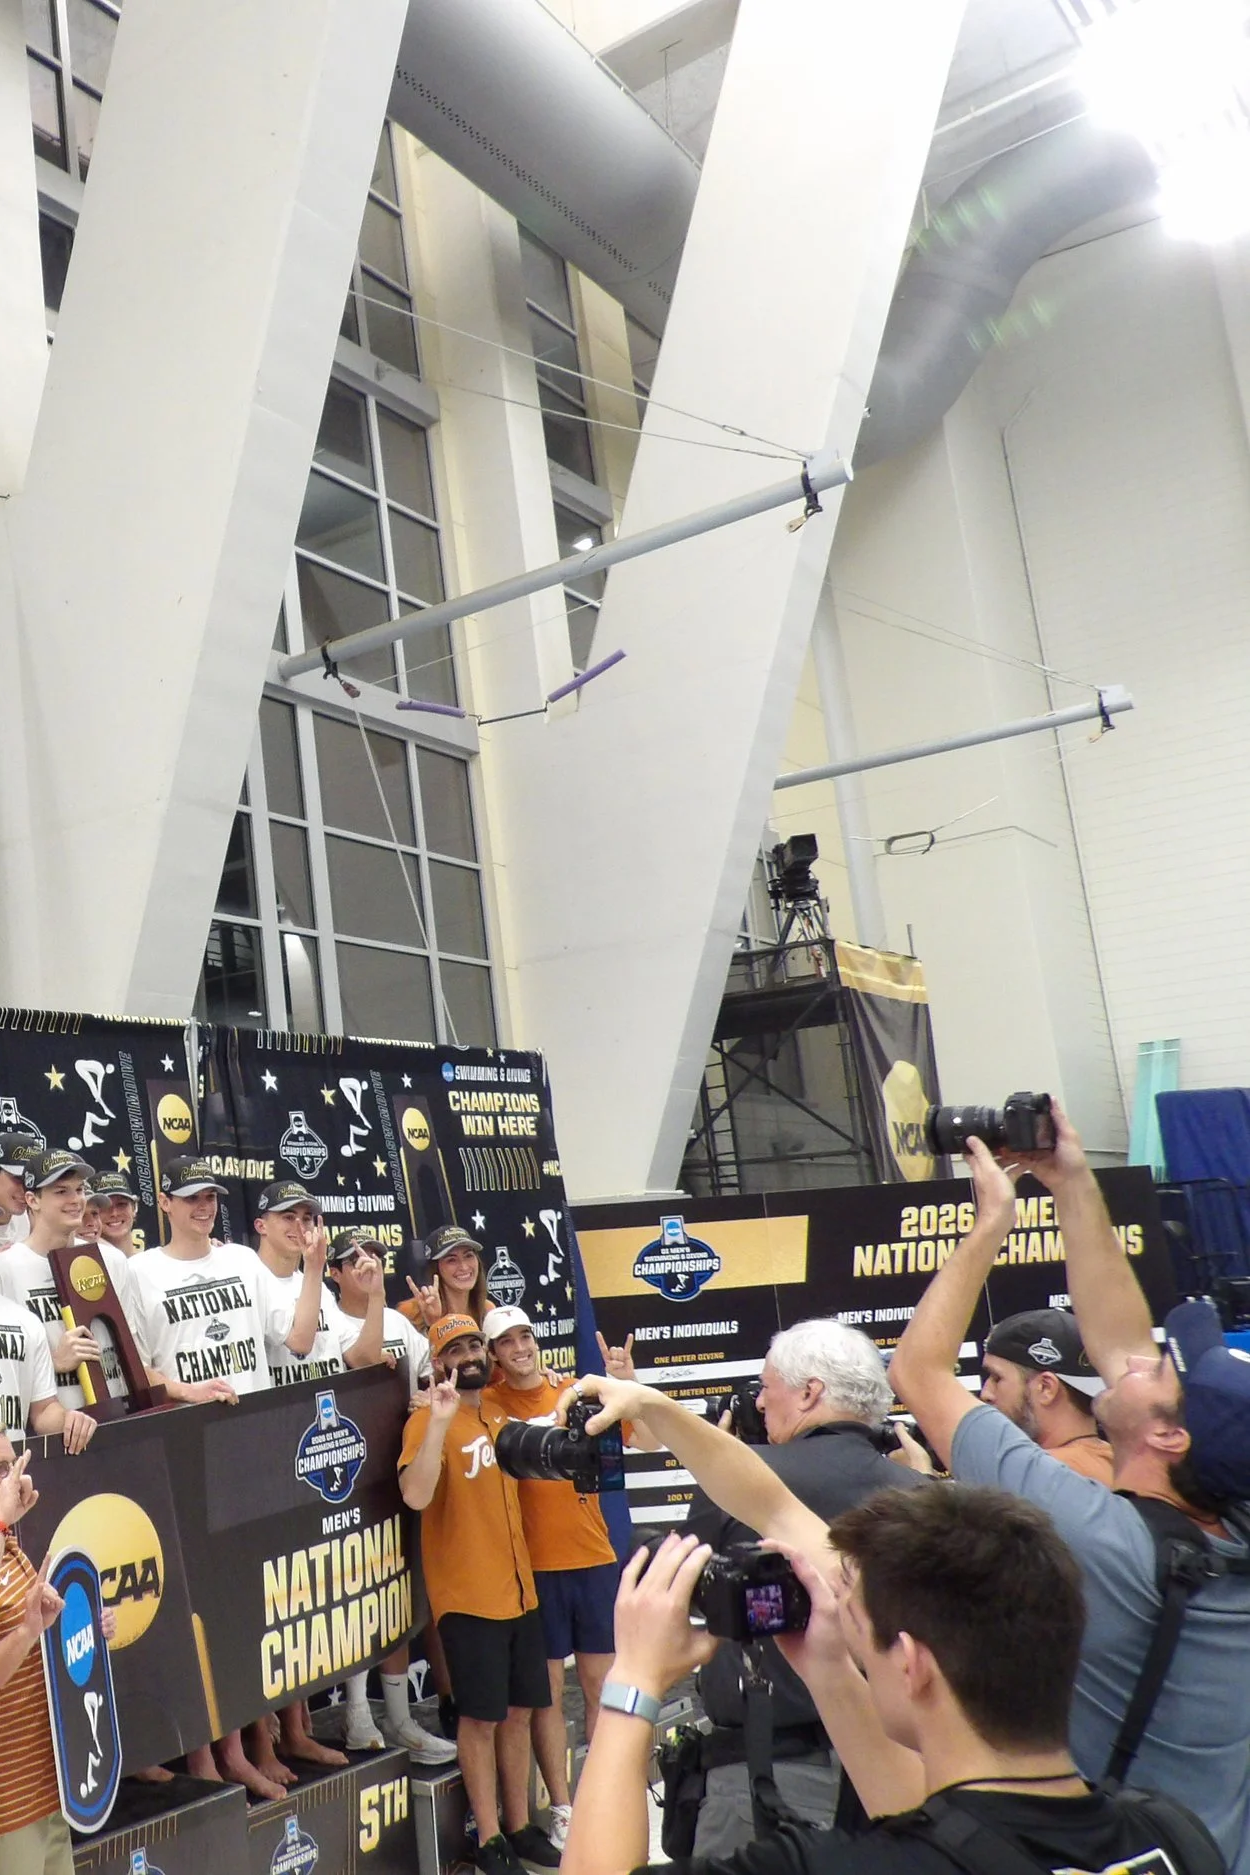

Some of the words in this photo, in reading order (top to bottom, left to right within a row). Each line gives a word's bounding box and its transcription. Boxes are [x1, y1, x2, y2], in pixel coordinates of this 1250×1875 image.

[454, 1064, 498, 1083] SWIMMING
[448, 1090, 541, 1113] CHAMPIONS
[162, 1117, 191, 1131] NCAA
[406, 1126, 429, 1140] NCAA
[461, 1115, 494, 1136] WIN
[497, 1115, 537, 1137] HERE
[900, 1202, 975, 1239] 2026
[634, 1257, 720, 1277] CHAMPIONSHIPS
[161, 1283, 252, 1325] NATIONAL
[634, 1326, 671, 1342] MEN'S
[672, 1320, 739, 1338] INDIVIDUALS
[654, 1356, 670, 1365] ONE
[671, 1354, 697, 1363] METER
[697, 1351, 725, 1361] DIVING
[678, 1387, 705, 1397] METER
[705, 1385, 733, 1395] DIVING
[298, 1441, 365, 1475] CHAMPIONSHIPS
[321, 1507, 361, 1535] MEN'S
[100, 1556, 161, 1607] CAA
[262, 1513, 406, 1627] NATIONAL
[65, 1623, 95, 1667] NCAA
[260, 1569, 413, 1701] CHAMPION
[358, 1776, 409, 1854] 5TH
